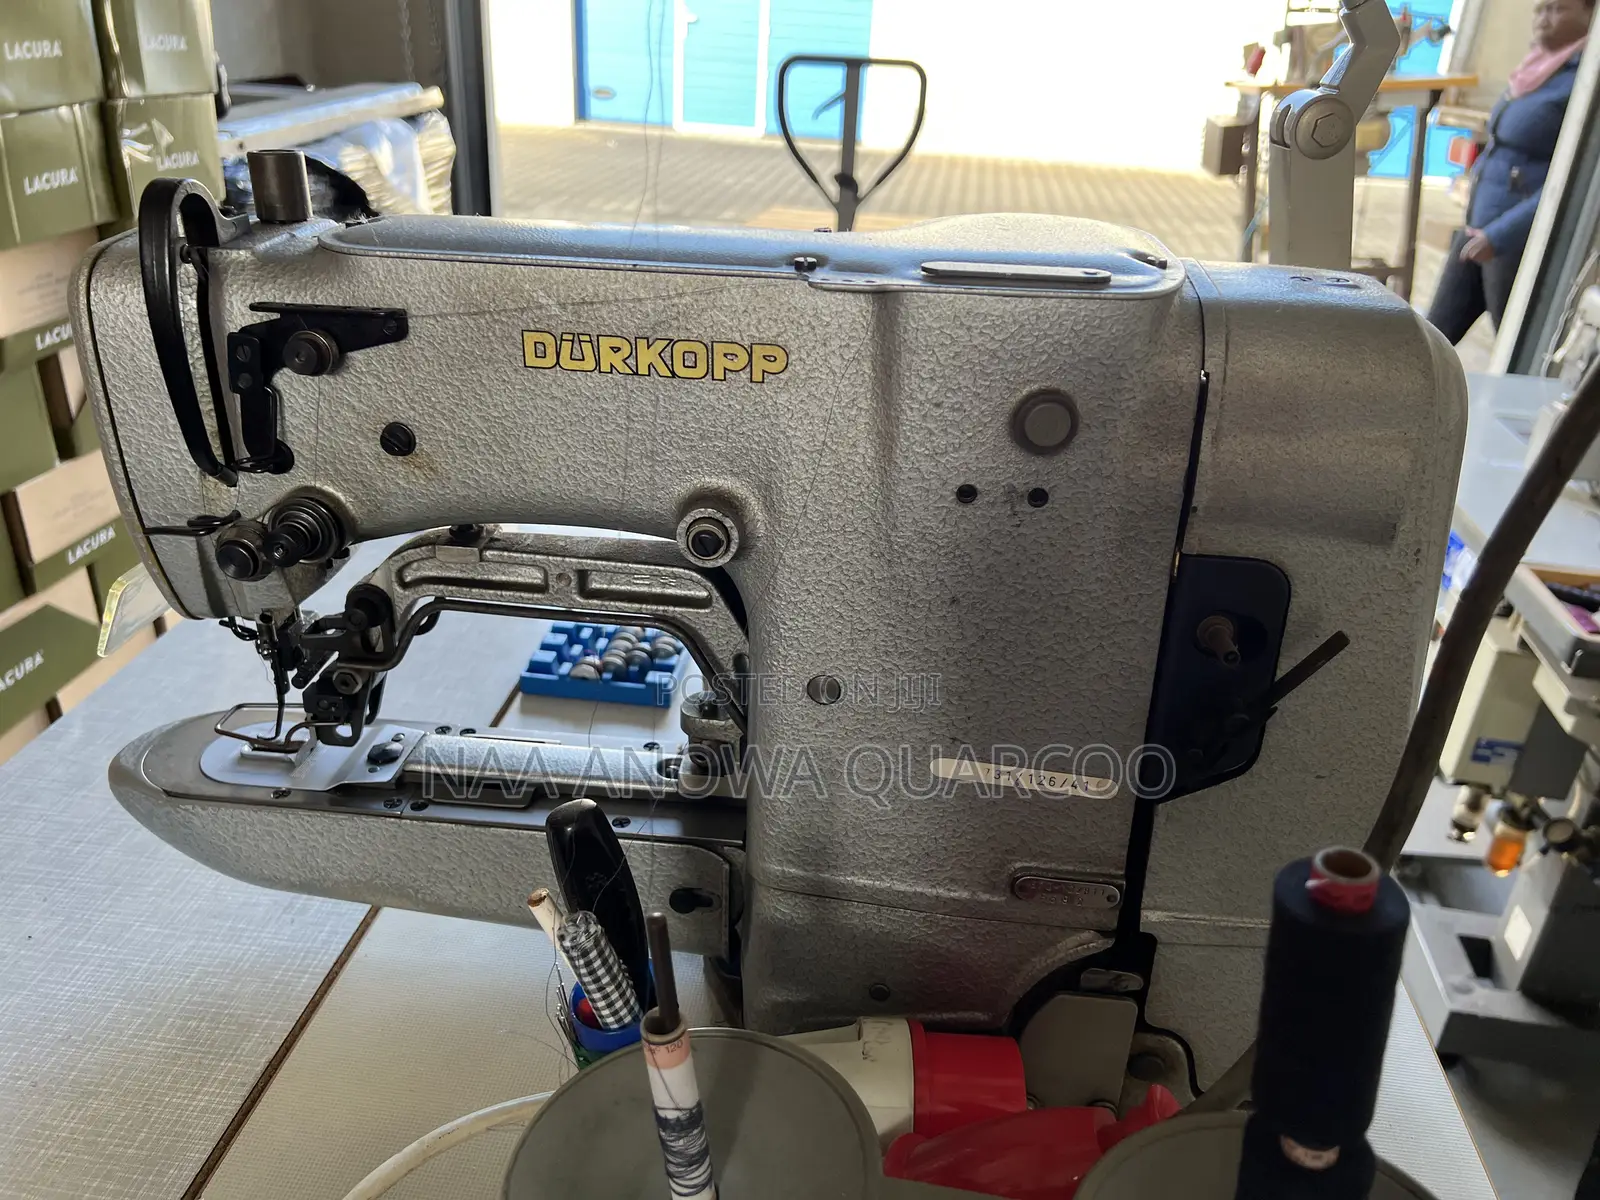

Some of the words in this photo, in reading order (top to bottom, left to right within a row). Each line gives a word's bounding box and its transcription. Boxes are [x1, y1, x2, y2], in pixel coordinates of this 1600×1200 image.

[4, 40, 62, 60] LACURA
[156, 151, 199, 171] LACURA
[24, 167, 79, 195] LACURA
[35, 322, 73, 351] LACU
[522, 330, 789, 383] DÜRKOPP
[67, 526, 116, 565] LACURA
